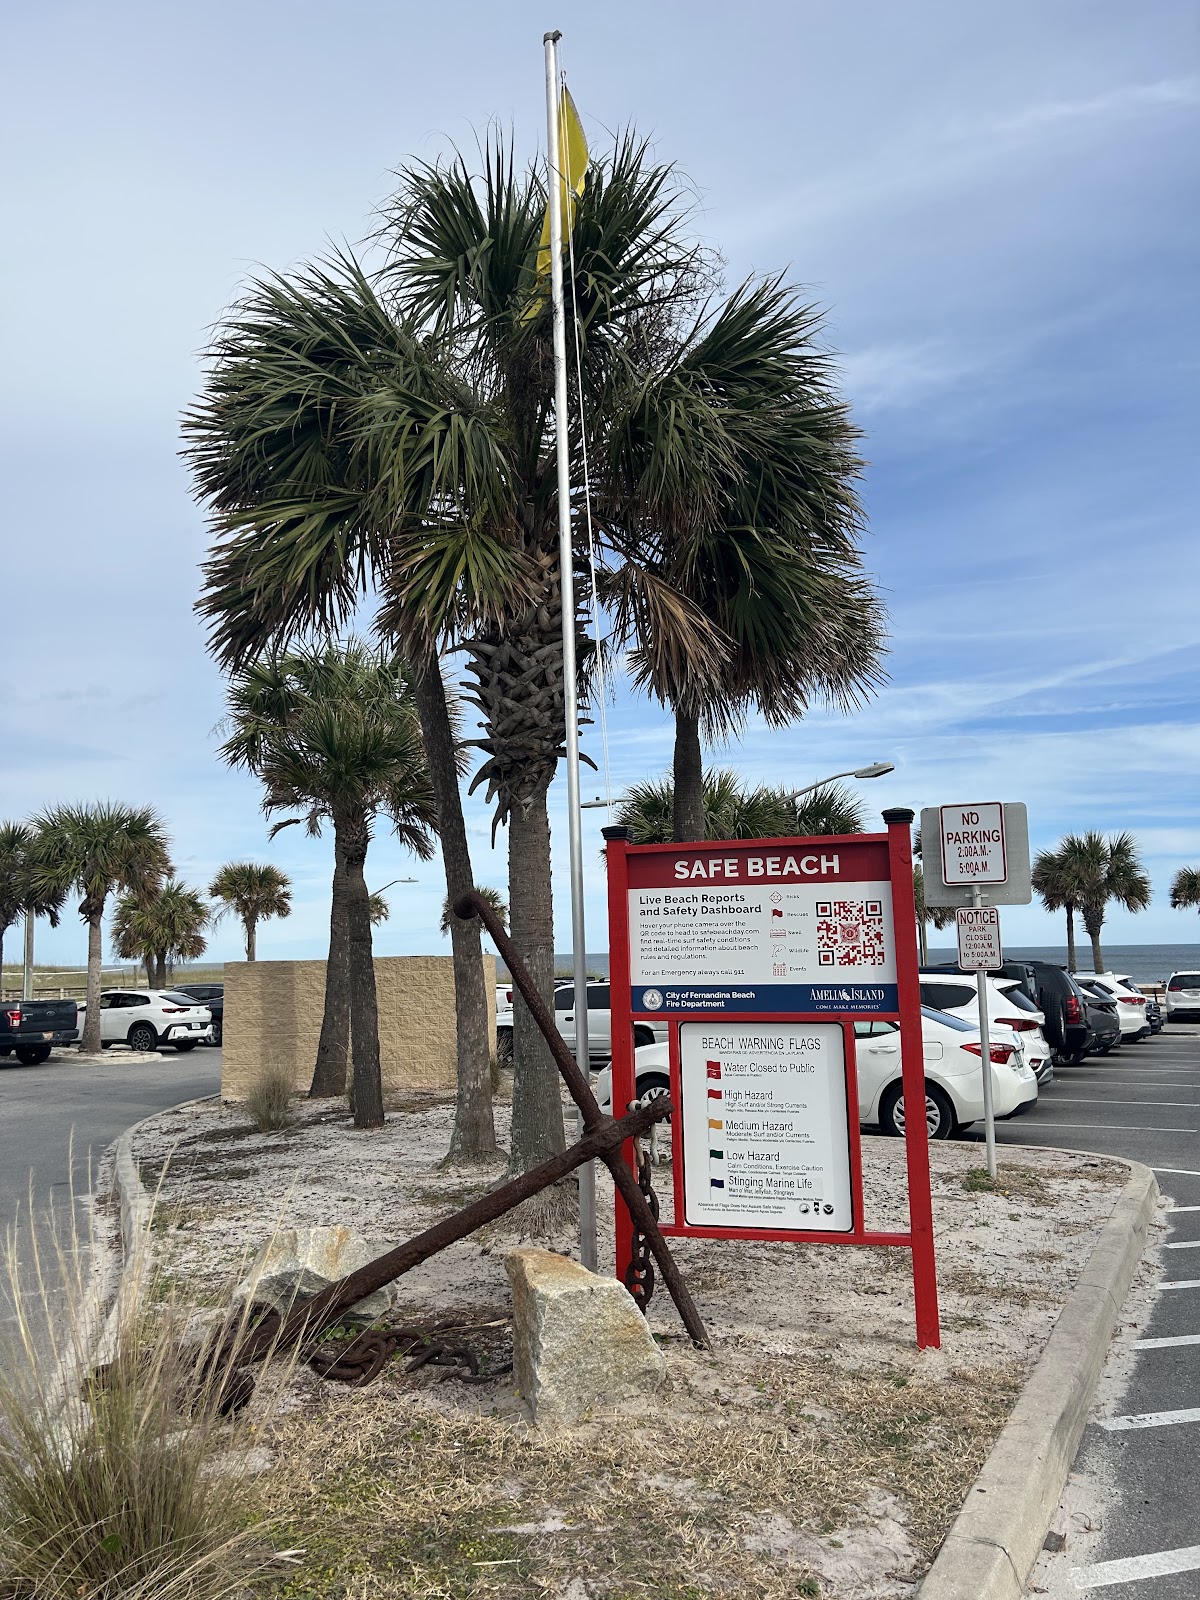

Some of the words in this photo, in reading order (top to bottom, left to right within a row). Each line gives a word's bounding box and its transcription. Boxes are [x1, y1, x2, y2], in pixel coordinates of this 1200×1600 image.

[961, 812, 980, 826] NO
[946, 829, 1001, 845] PARKING
[674, 858, 740, 880] SAFE
[747, 854, 840, 877] BEACH
[639, 896, 662, 905] Live
[664, 894, 699, 904] Beach
[701, 893, 746, 905] Reports
[639, 907, 660, 916] and
[663, 906, 698, 917] Safety
[701, 904, 762, 915] Dashboard
[960, 911, 996, 925] NOTICE
[673, 922, 694, 930] phone
[696, 937, 716, 945] safety
[661, 969, 697, 977] Emergency
[697, 969, 720, 977] always
[665, 991, 680, 1000] City
[680, 991, 689, 999] of
[690, 991, 731, 999] Fernandina
[731, 991, 756, 999] Beach
[809, 988, 843, 1001] AMELIA
[850, 987, 885, 1000] ISLAND
[665, 1000, 681, 1008] Fire
[681, 1000, 725, 1008] Department
[702, 1037, 734, 1050] BEACH
[738, 1037, 784, 1050] WARNING
[789, 1037, 821, 1051] FLAGS
[723, 1062, 748, 1073] Water
[749, 1062, 777, 1073] Closed
[779, 1063, 788, 1073] to
[789, 1063, 815, 1073] Public
[724, 1089, 743, 1102] High
[744, 1090, 773, 1100] Hazard
[725, 1120, 760, 1131] Medium
[762, 1120, 793, 1132] Hazard
[726, 1150, 745, 1160] Low
[747, 1150, 780, 1162] Hazard
[728, 1175, 764, 1189] Stinging
[765, 1177, 795, 1189] Marine
[797, 1178, 813, 1189] Life
